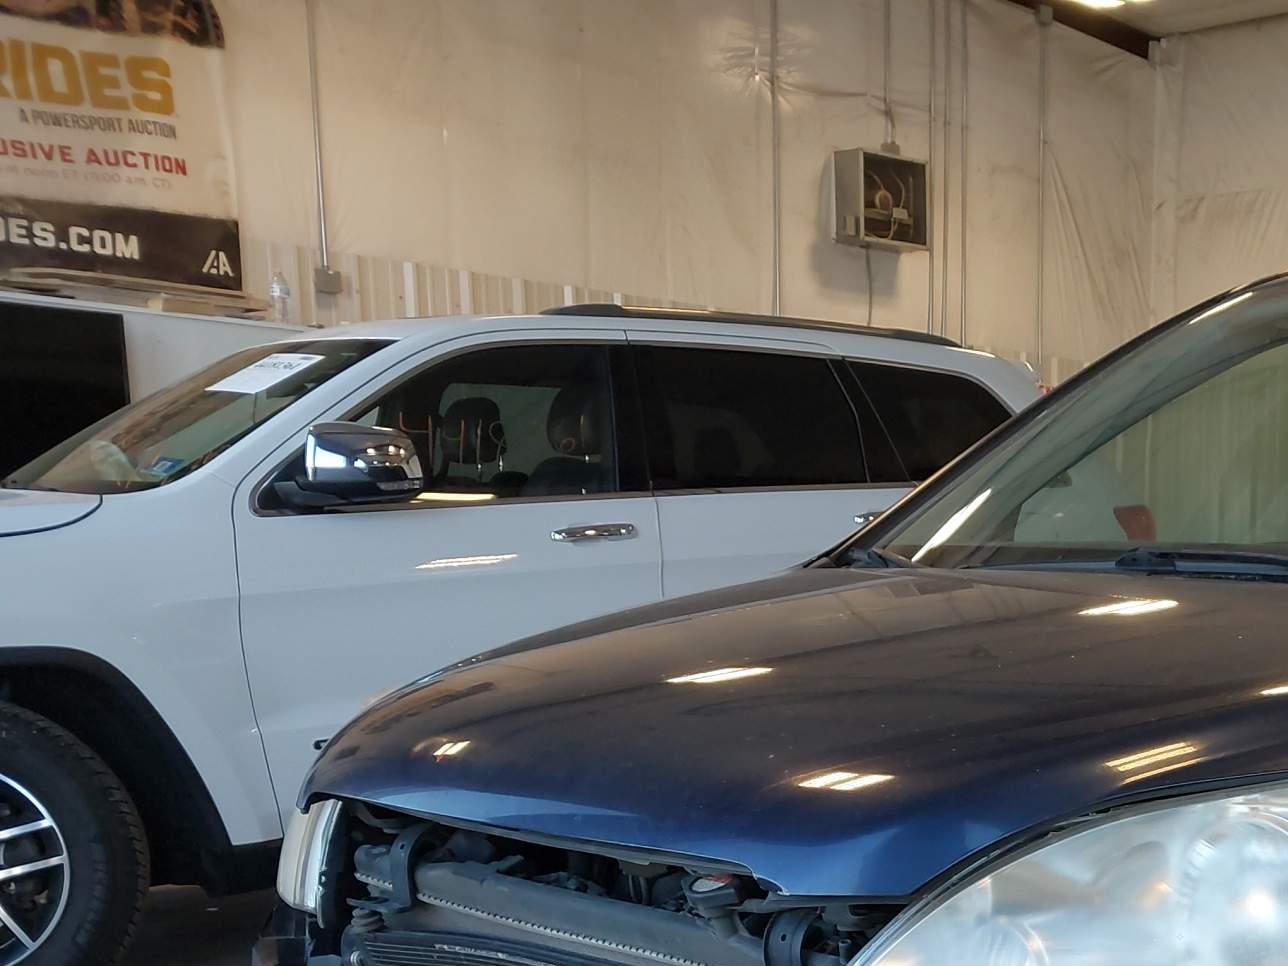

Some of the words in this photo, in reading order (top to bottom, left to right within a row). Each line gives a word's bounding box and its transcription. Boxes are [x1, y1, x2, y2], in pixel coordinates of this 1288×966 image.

[19, 106, 29, 124] A
[31, 109, 123, 132] POWERSPORT
[128, 118, 177, 139] AUCTION
[86, 147, 187, 176] AUCTION
[0, 217, 140, 260] ES.COM
